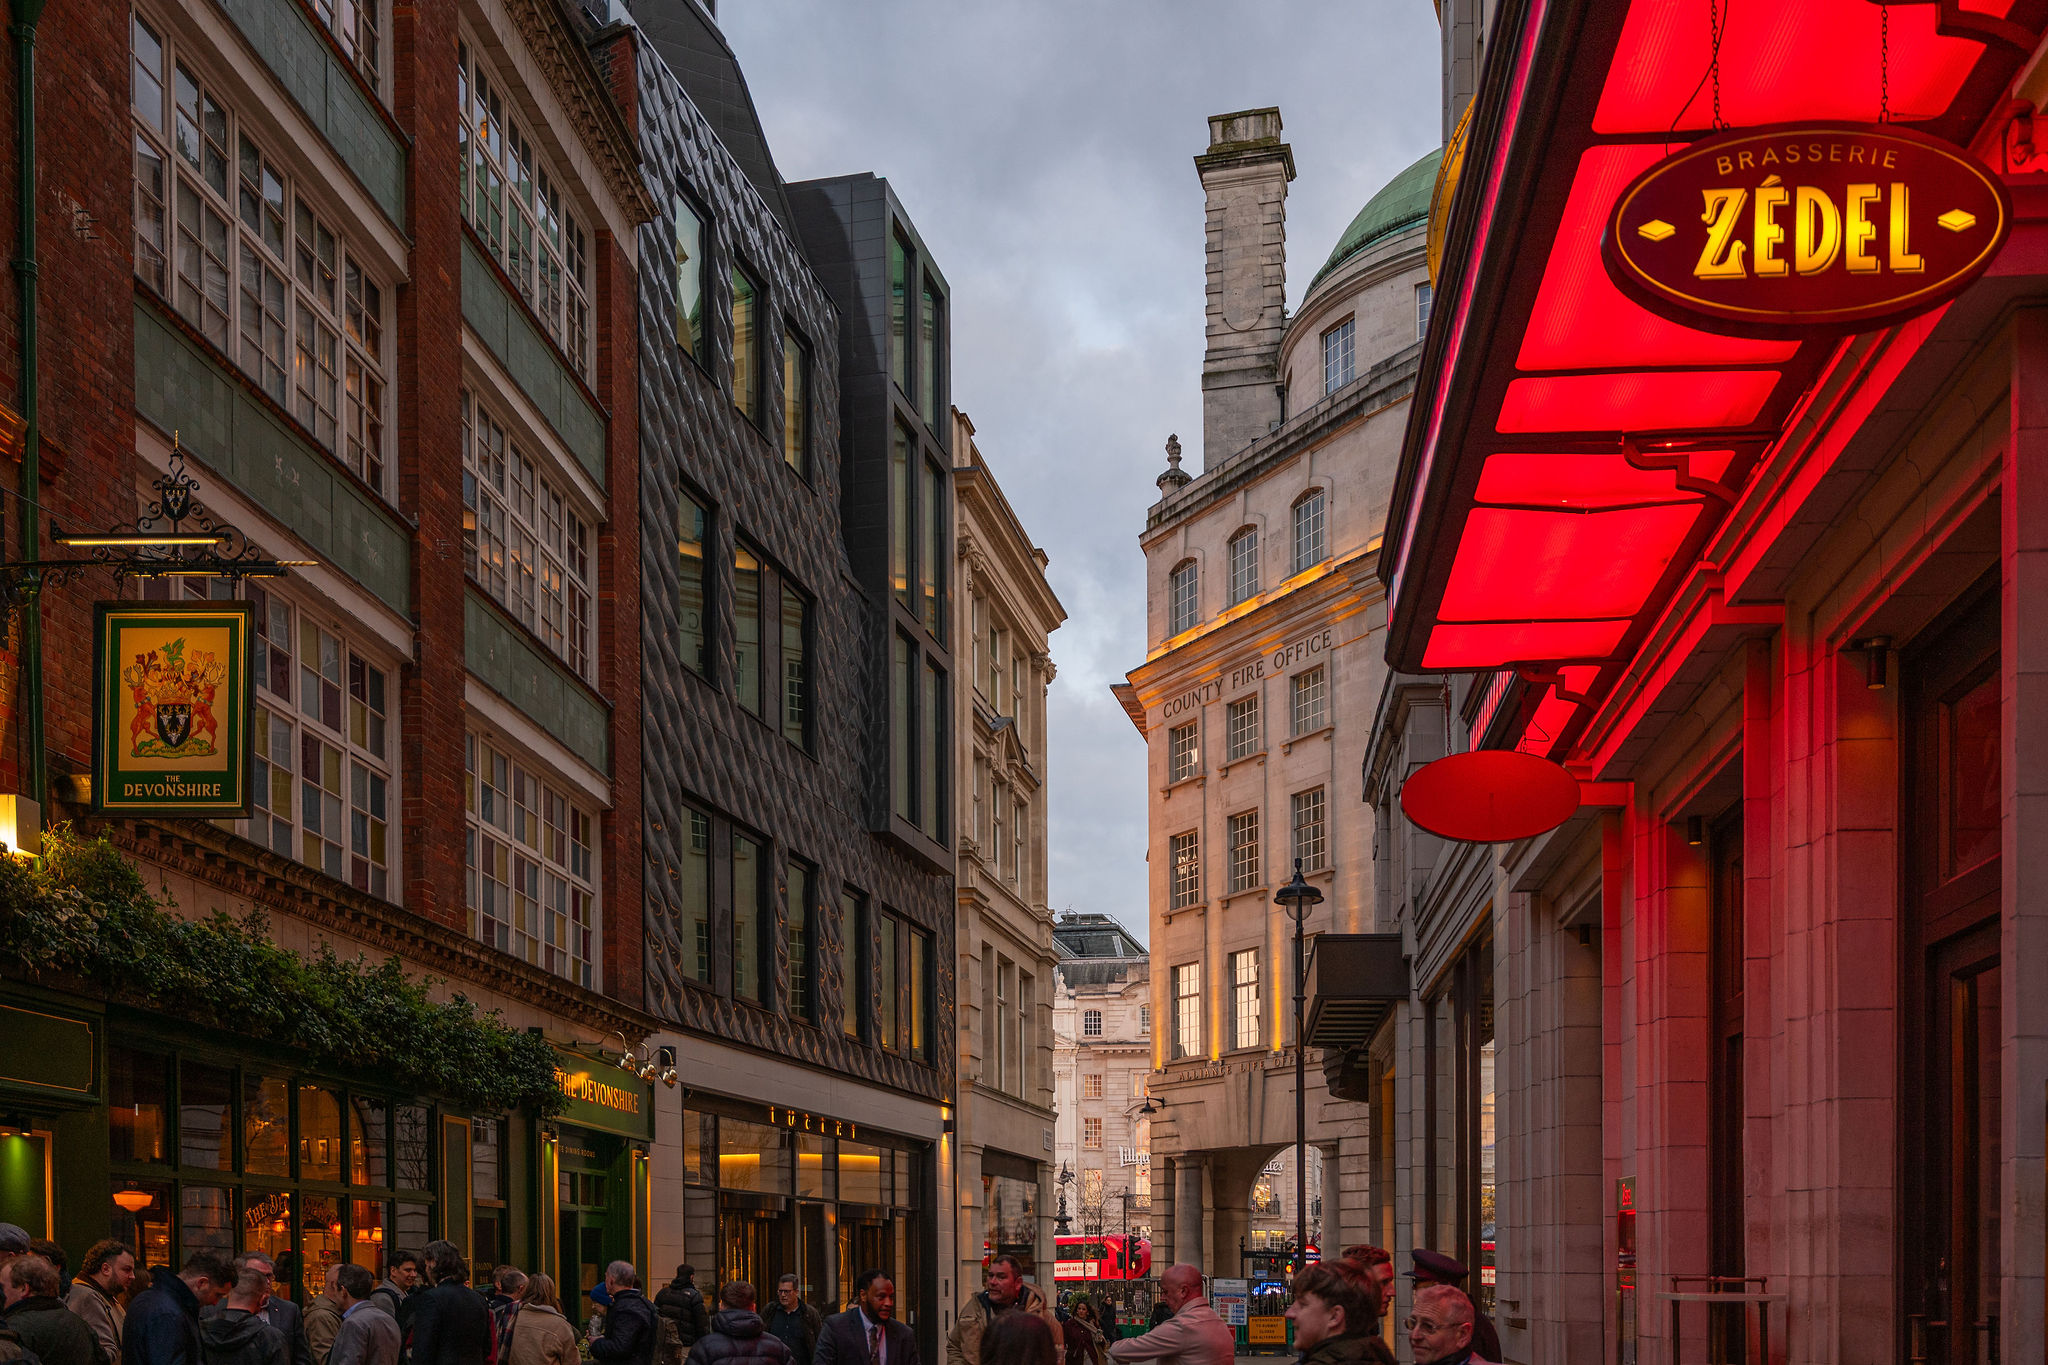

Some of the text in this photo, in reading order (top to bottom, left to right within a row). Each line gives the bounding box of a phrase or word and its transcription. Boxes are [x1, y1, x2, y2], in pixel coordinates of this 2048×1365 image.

[1716, 143, 1898, 175] BRASSERIE
[1693, 174, 1925, 280] ZÉDEL
[1163, 629, 1332, 718] COUNTY FIRE OFFICE
[124, 783, 221, 797] DEVONSHIRE
[165, 775, 181, 783] THE
[1179, 1053, 1315, 1081] ALLIANCE LIFE OFFE
[581, 1078, 639, 1114] DEVONSHIRE
[246, 1203, 267, 1228] THE
